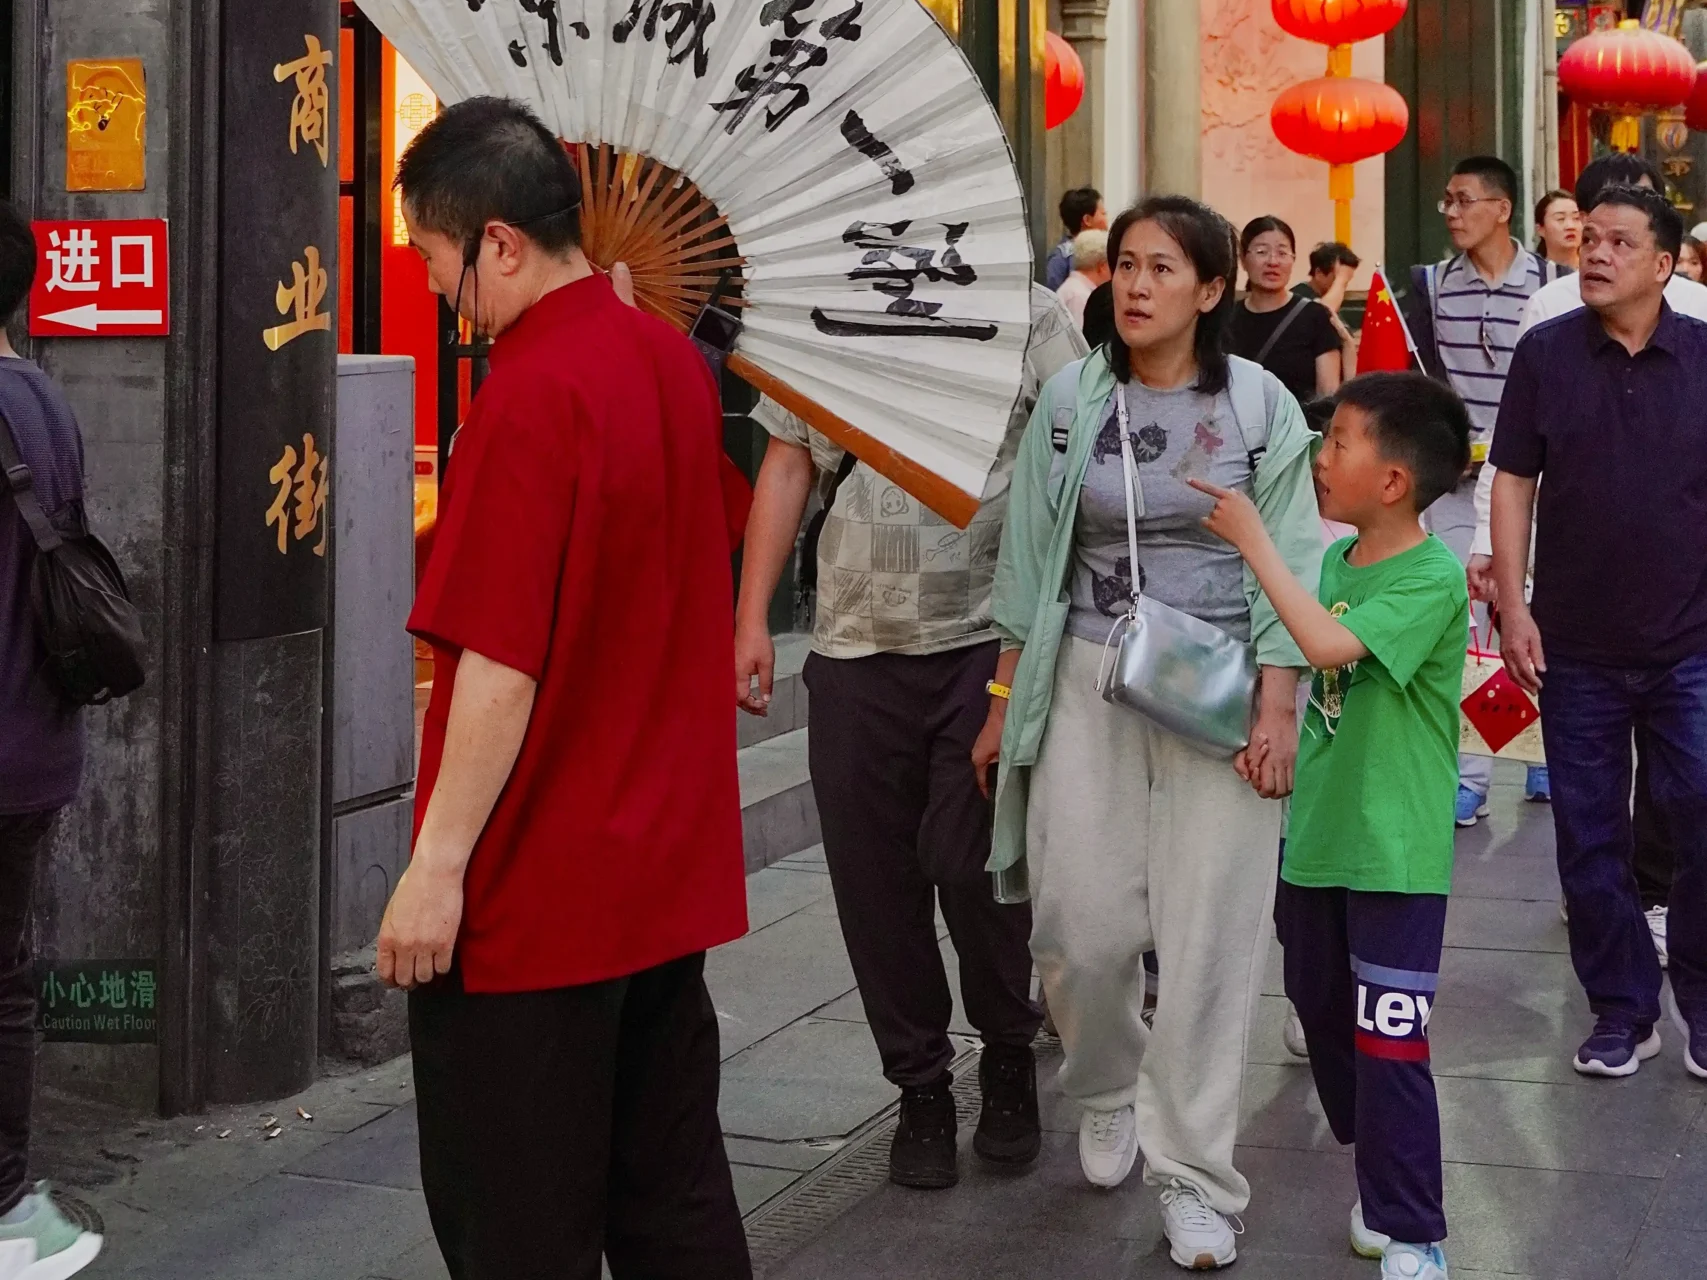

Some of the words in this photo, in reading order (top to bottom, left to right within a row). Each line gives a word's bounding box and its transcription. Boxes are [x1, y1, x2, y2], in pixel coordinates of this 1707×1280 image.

[45, 228, 153, 293] 进口
[41, 970, 157, 1009] 小心地滑
[43, 1013, 91, 1031] Caution
[93, 1014, 120, 1031] Wet
[124, 1013, 157, 1031] Floor
